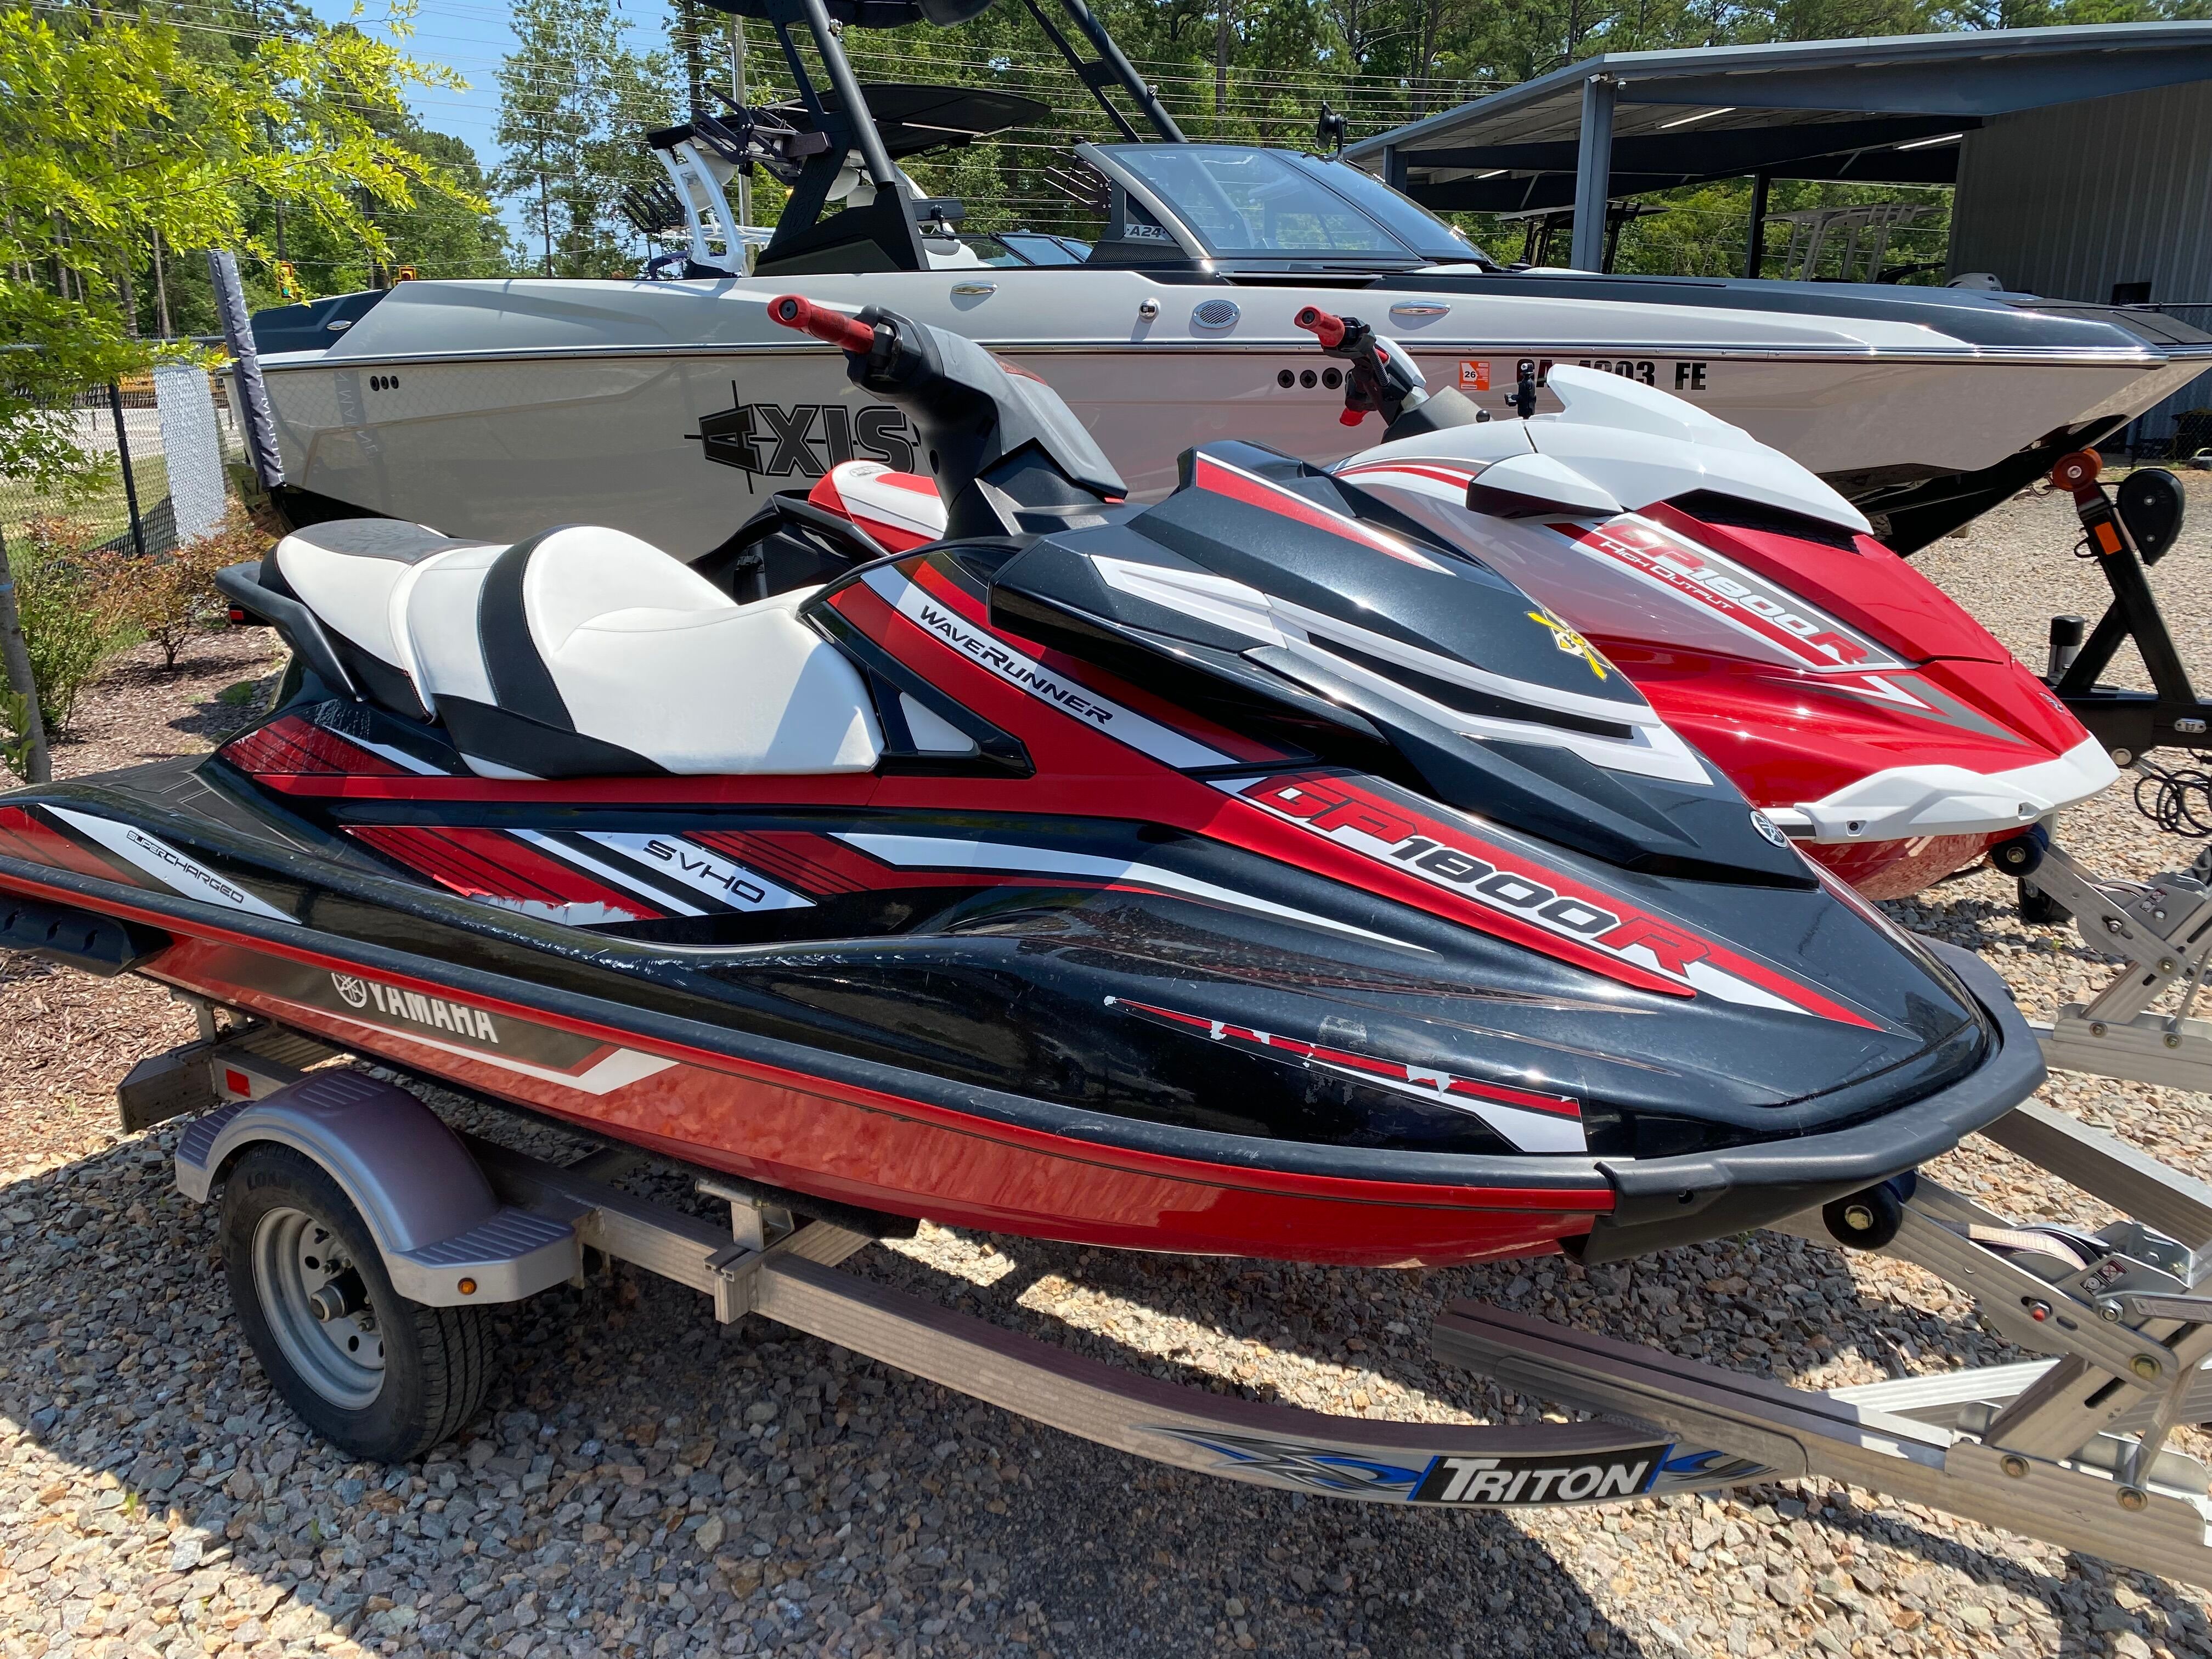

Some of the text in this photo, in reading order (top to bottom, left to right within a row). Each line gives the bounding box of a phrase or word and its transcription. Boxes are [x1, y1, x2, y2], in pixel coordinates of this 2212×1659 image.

[1129, 225, 1161, 238] A24
[1675, 362, 1707, 390] FE
[698, 403, 916, 478] AXIS
[1595, 523, 1870, 665] GP1800R
[1599, 540, 1736, 610] HIGH OUTPUT
[919, 605, 1114, 725] WAVERUNNER
[126, 830, 244, 904] SUPERCHARGED
[642, 839, 766, 904] SVHO
[1236, 775, 1713, 978] GP1800R
[367, 981, 499, 1045] YAMAHA
[1440, 1458, 1649, 1502] TRITON
